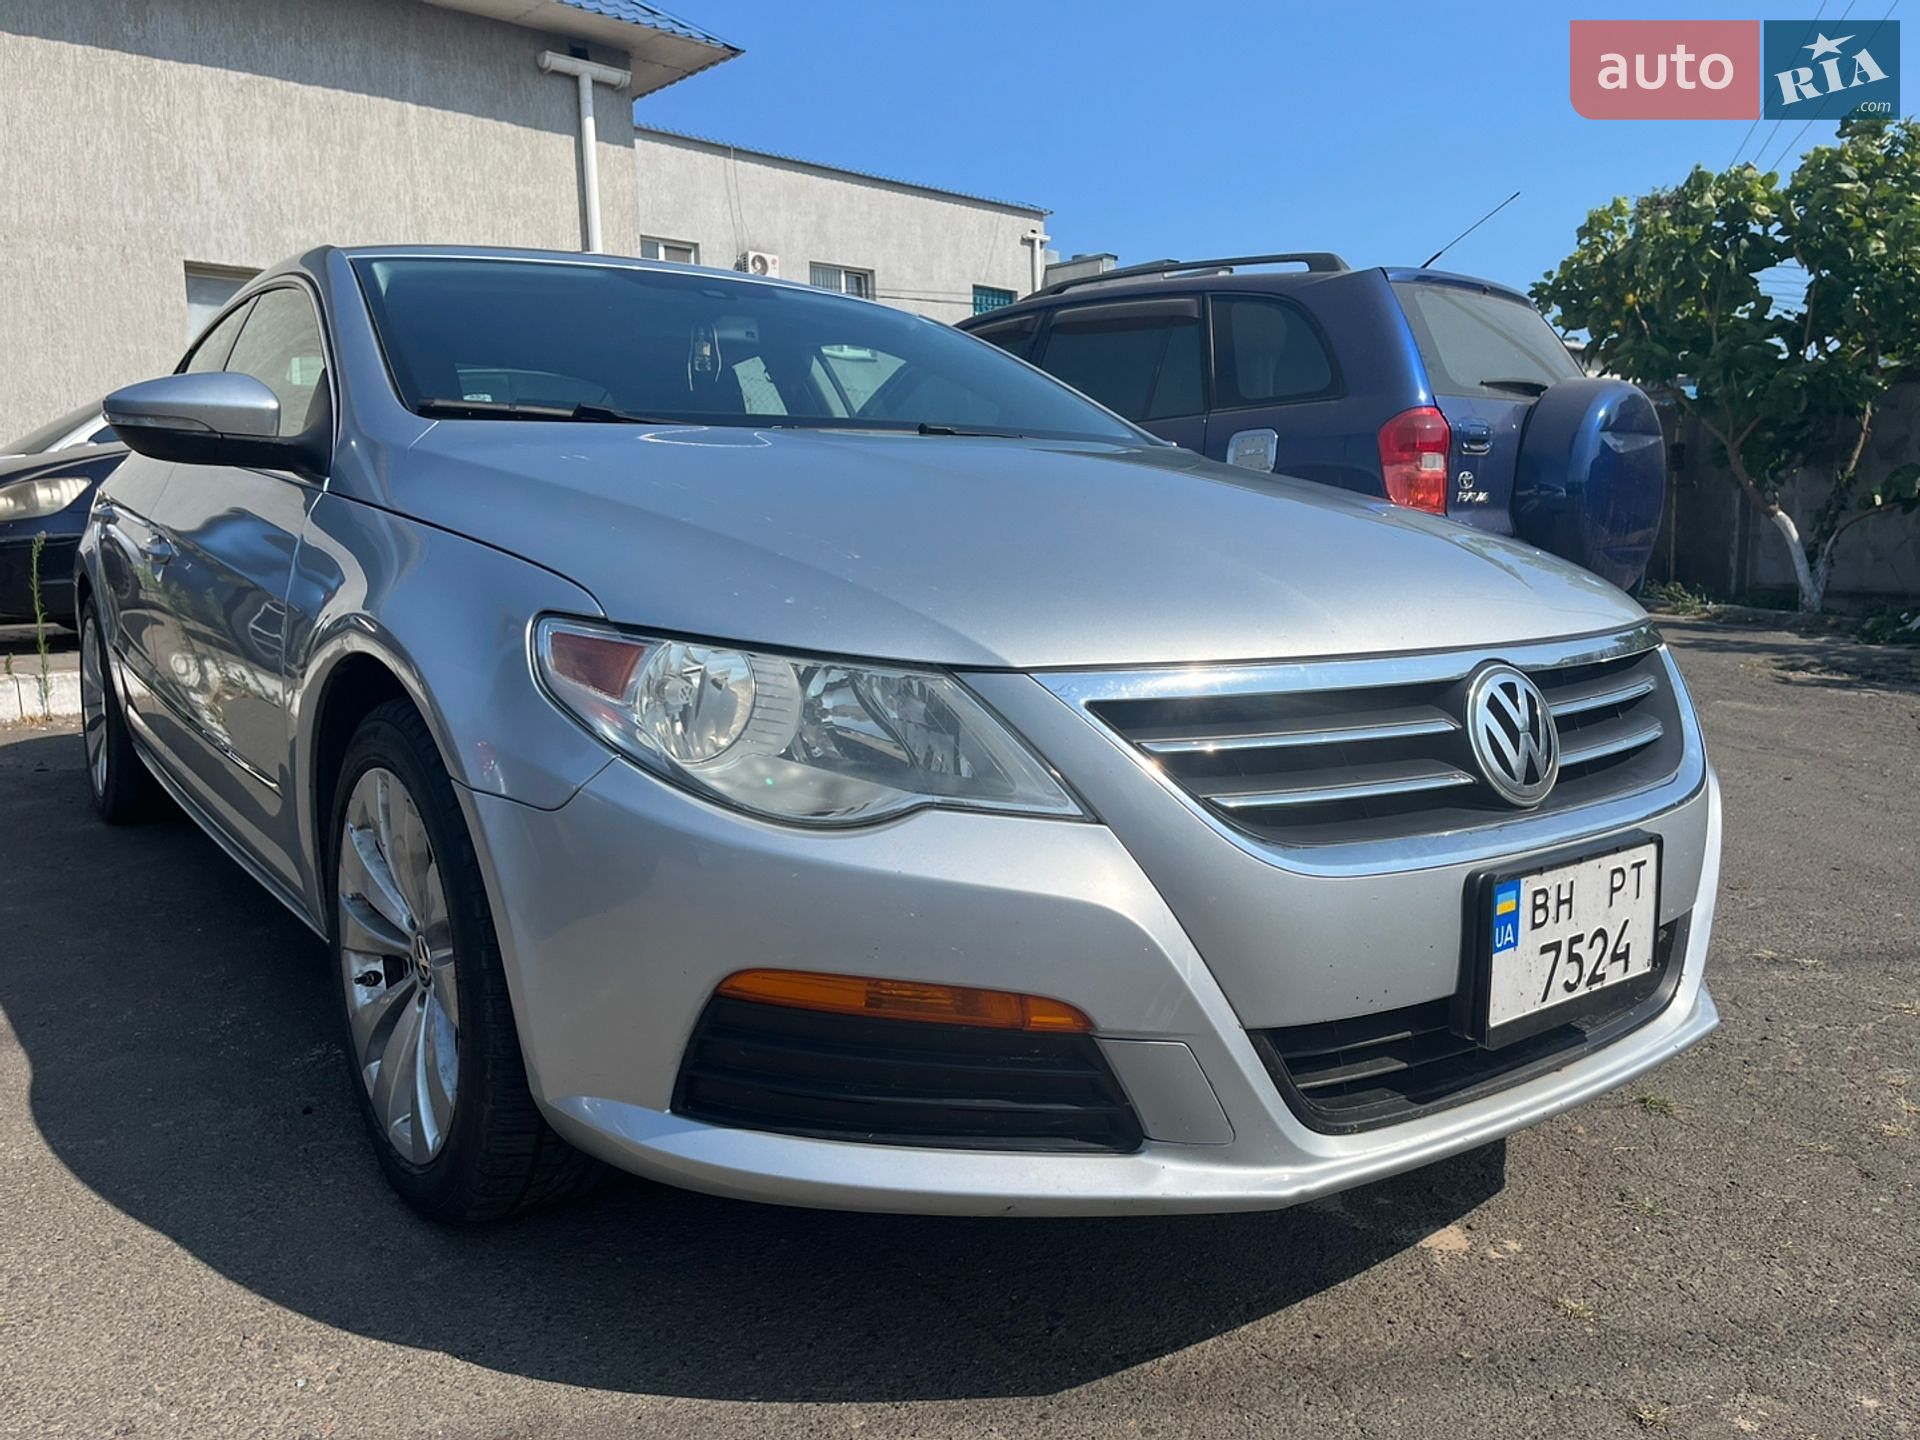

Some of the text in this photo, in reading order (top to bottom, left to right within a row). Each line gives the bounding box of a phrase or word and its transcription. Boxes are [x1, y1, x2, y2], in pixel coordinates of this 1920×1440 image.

[1530, 859, 1647, 931] BH PT
[1495, 924, 1515, 948] UA
[1539, 918, 1631, 1003] 7524
